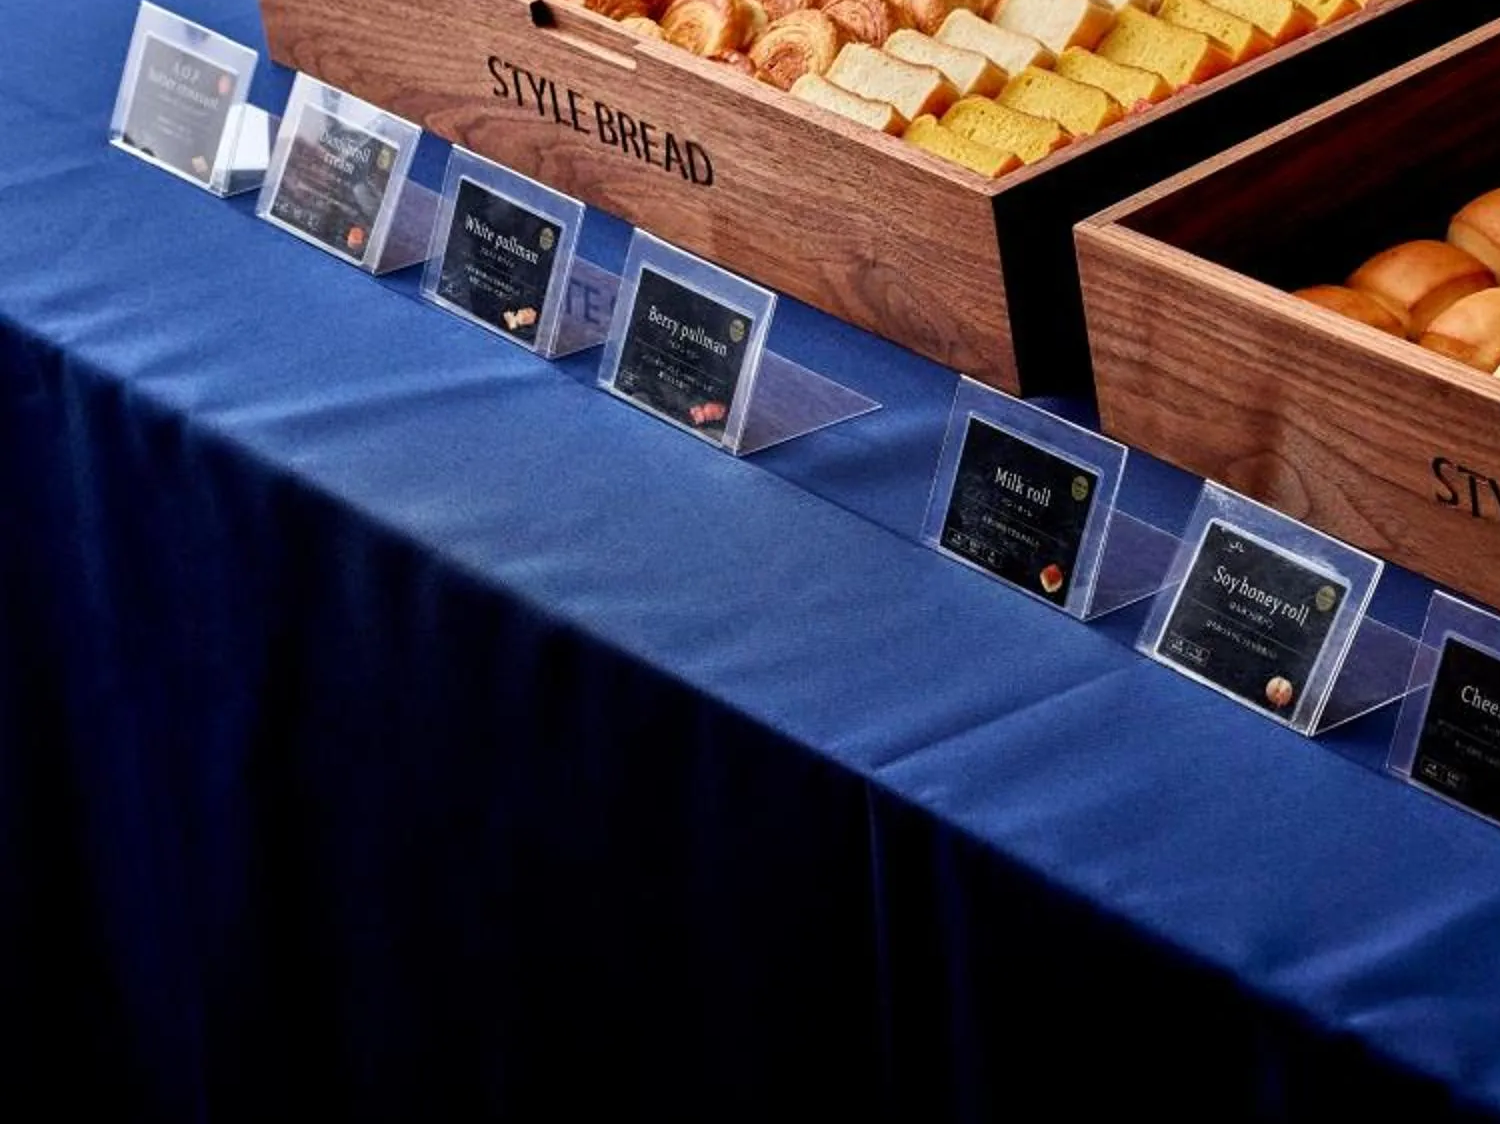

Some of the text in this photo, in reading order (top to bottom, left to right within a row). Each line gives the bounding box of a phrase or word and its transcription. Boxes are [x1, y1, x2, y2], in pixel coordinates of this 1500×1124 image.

[487, 55, 714, 186] STYLE BREAD
[465, 214, 495, 243] White
[494, 235, 539, 265] pullman
[648, 304, 679, 336] Berry
[680, 326, 728, 357] pullman
[994, 466, 1025, 495] Milk
[1025, 487, 1051, 507] roll
[1213, 565, 1241, 595] Soy
[1240, 576, 1282, 615] honey
[1281, 603, 1311, 628] roll
